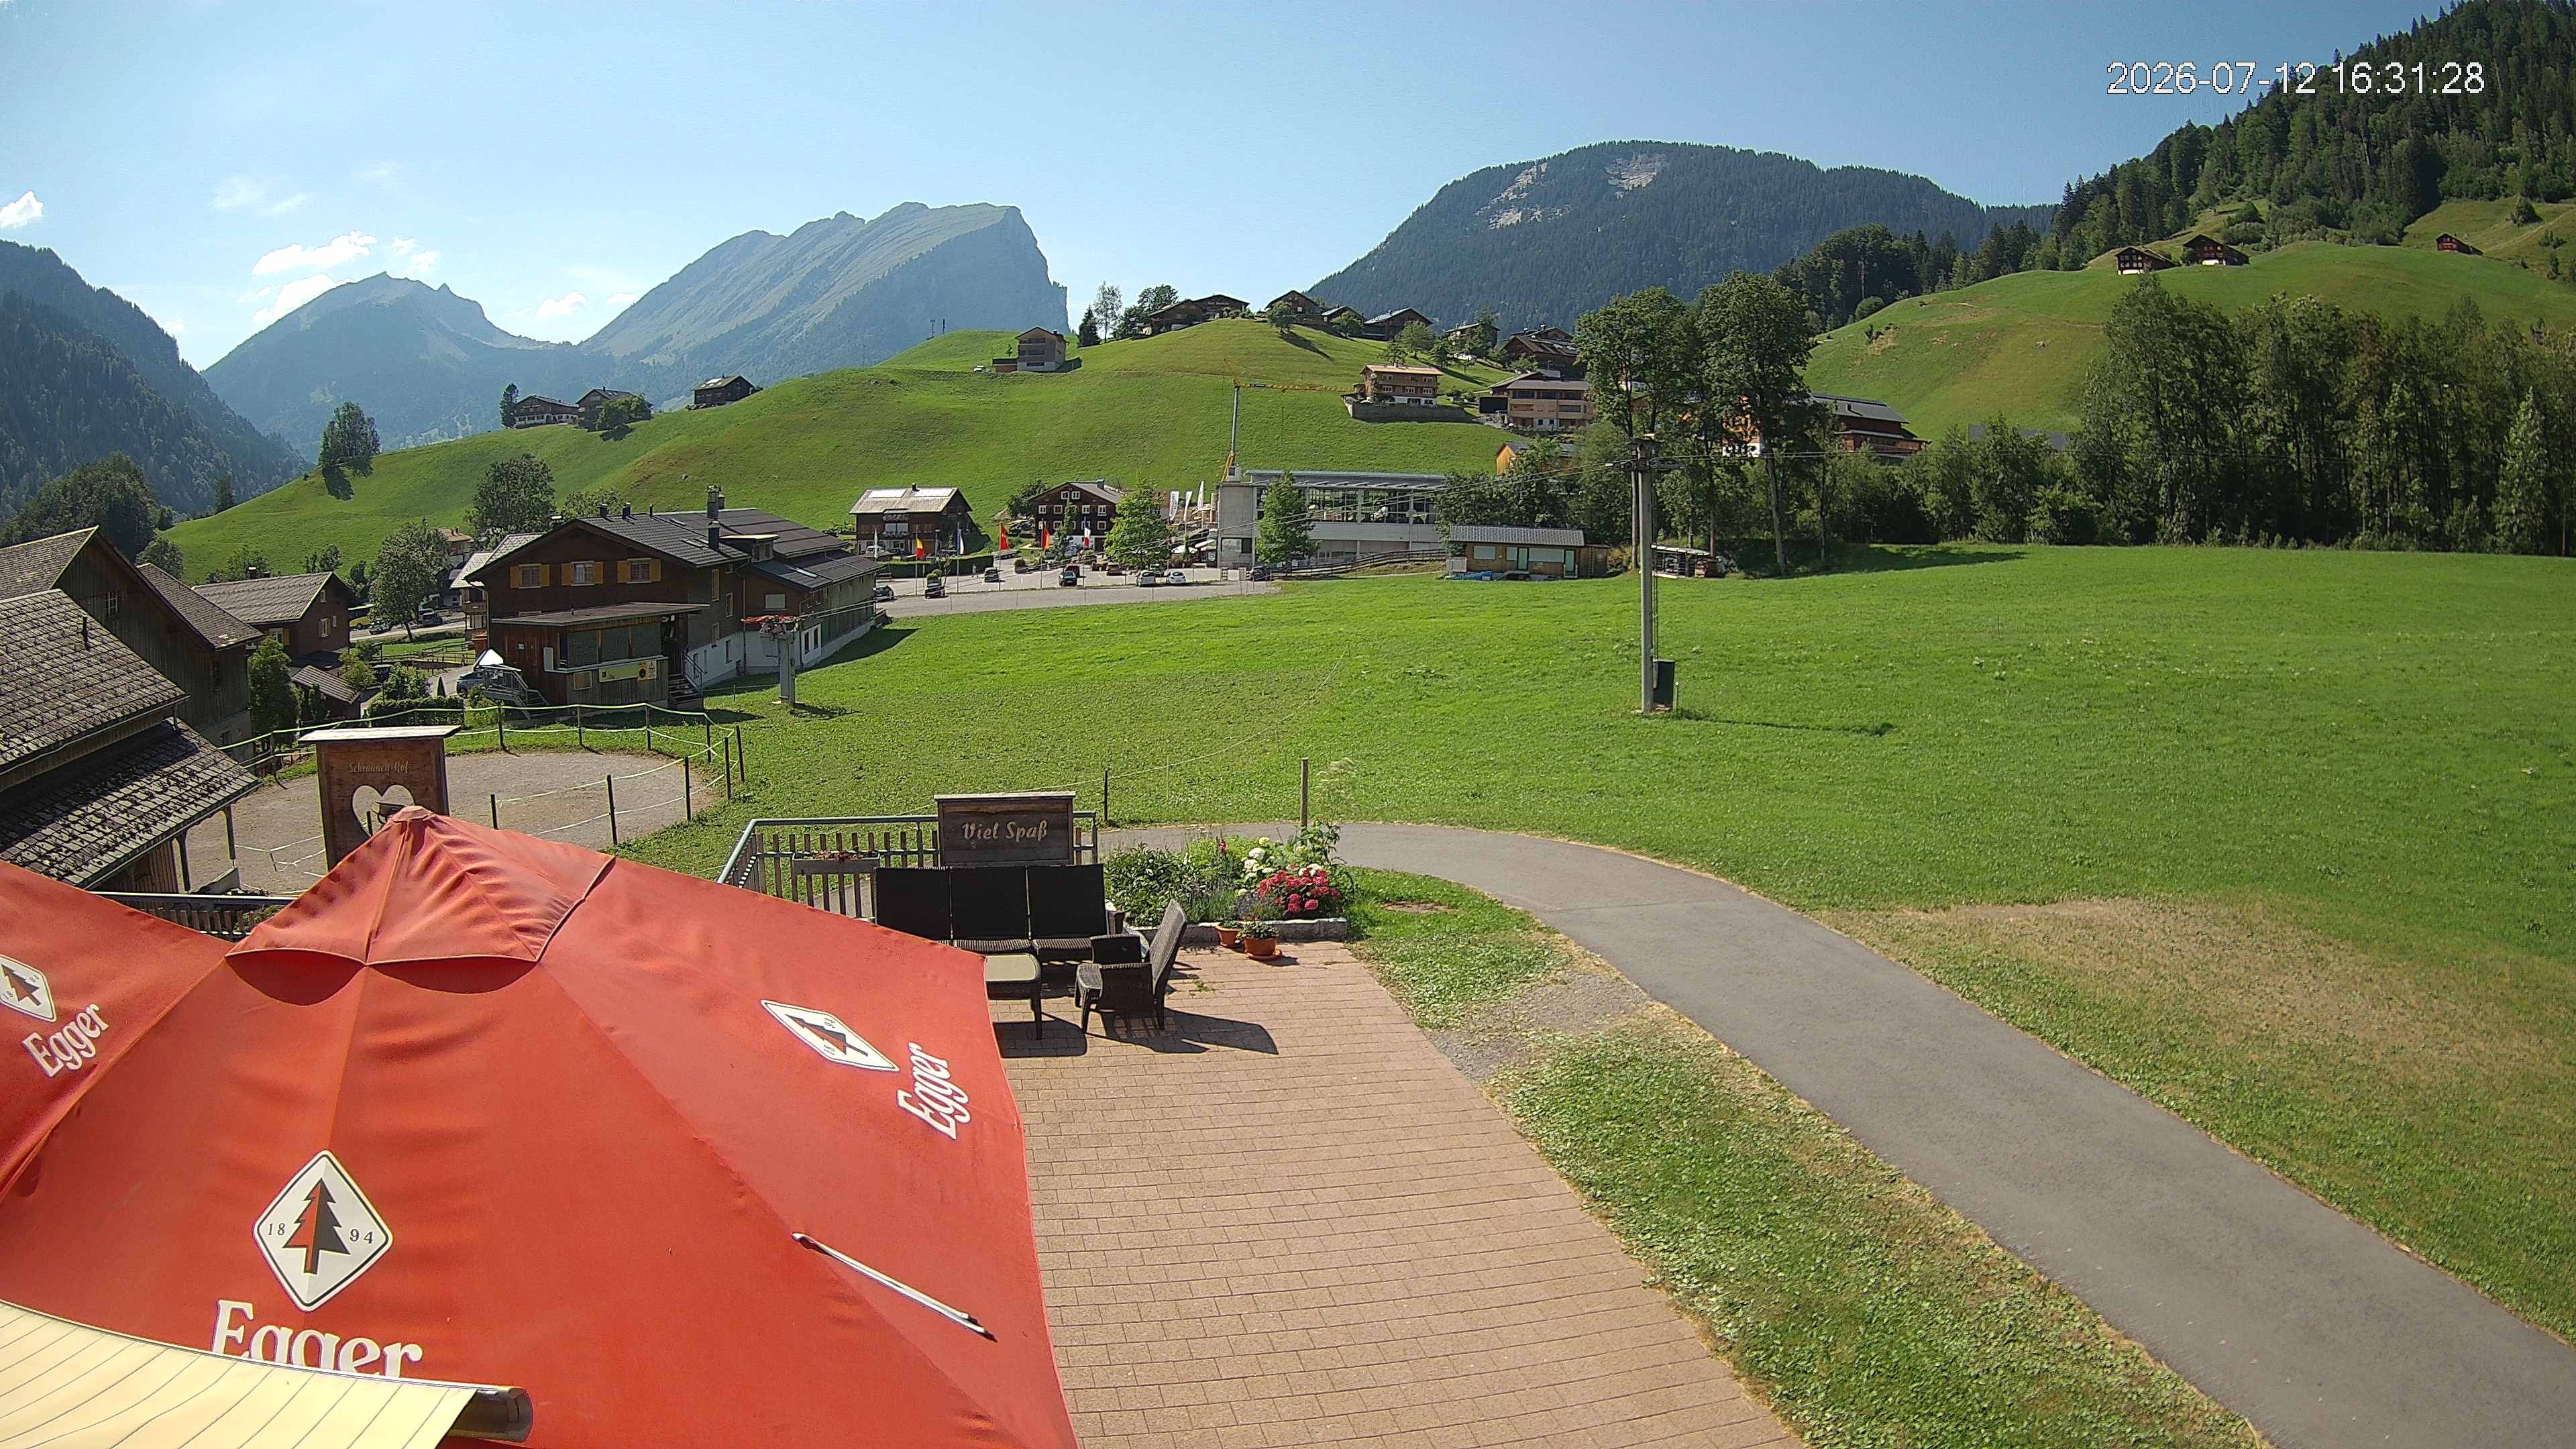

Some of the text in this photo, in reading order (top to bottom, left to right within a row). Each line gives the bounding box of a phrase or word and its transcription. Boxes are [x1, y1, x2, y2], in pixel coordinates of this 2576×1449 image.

[962, 820, 1048, 843] Viel Spaß
[21, 1004, 109, 1077] Egger
[896, 1042, 971, 1140] Egger
[268, 1223, 374, 1244] 18 94
